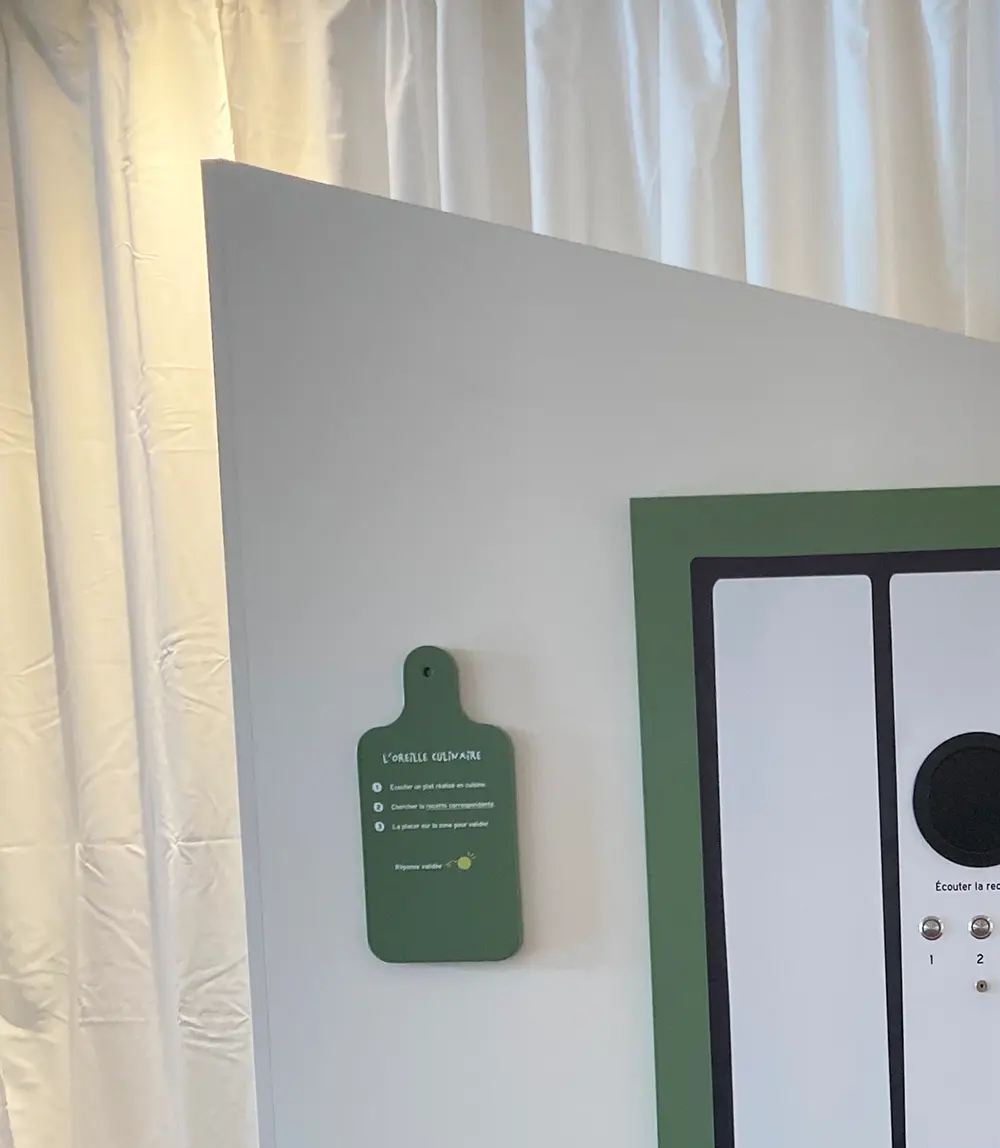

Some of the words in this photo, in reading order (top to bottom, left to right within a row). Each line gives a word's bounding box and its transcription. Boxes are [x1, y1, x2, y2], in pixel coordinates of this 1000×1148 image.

[935, 880, 972, 892] Écouter
[975, 881, 984, 891] la
[929, 954, 934, 965] 1
[976, 953, 984, 965] 2
